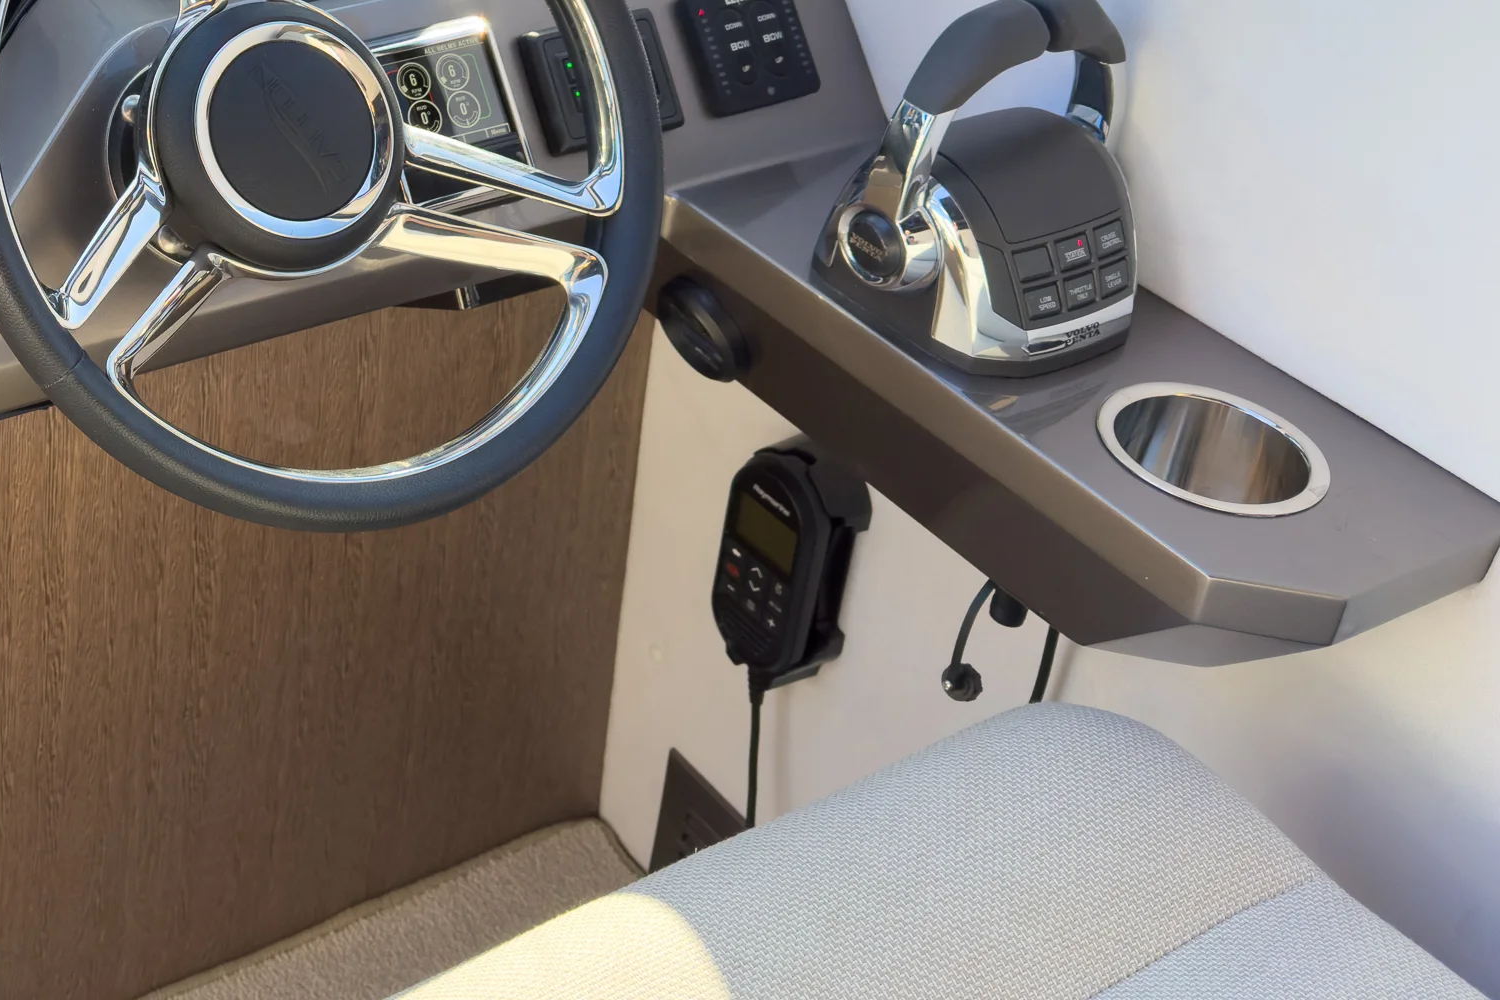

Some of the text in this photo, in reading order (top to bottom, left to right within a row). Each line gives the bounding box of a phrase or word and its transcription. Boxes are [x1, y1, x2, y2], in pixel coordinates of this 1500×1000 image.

[424, 46, 434, 55] ALL
[437, 42, 457, 52] HELMS
[1101, 231, 1116, 243] CRUISE
[1102, 238, 1122, 249] CONTROL
[1064, 249, 1086, 260] STATION
[1105, 271, 1121, 283] SINGLE
[1107, 278, 1122, 289] LEVER
[1069, 283, 1093, 296] THROTTLE
[1040, 295, 1052, 303] LOW
[1077, 292, 1088, 301] ONLY
[1039, 301, 1056, 311] SPEED
[1065, 321, 1100, 339] VOLVO
[1064, 329, 1101, 348] PENTA
